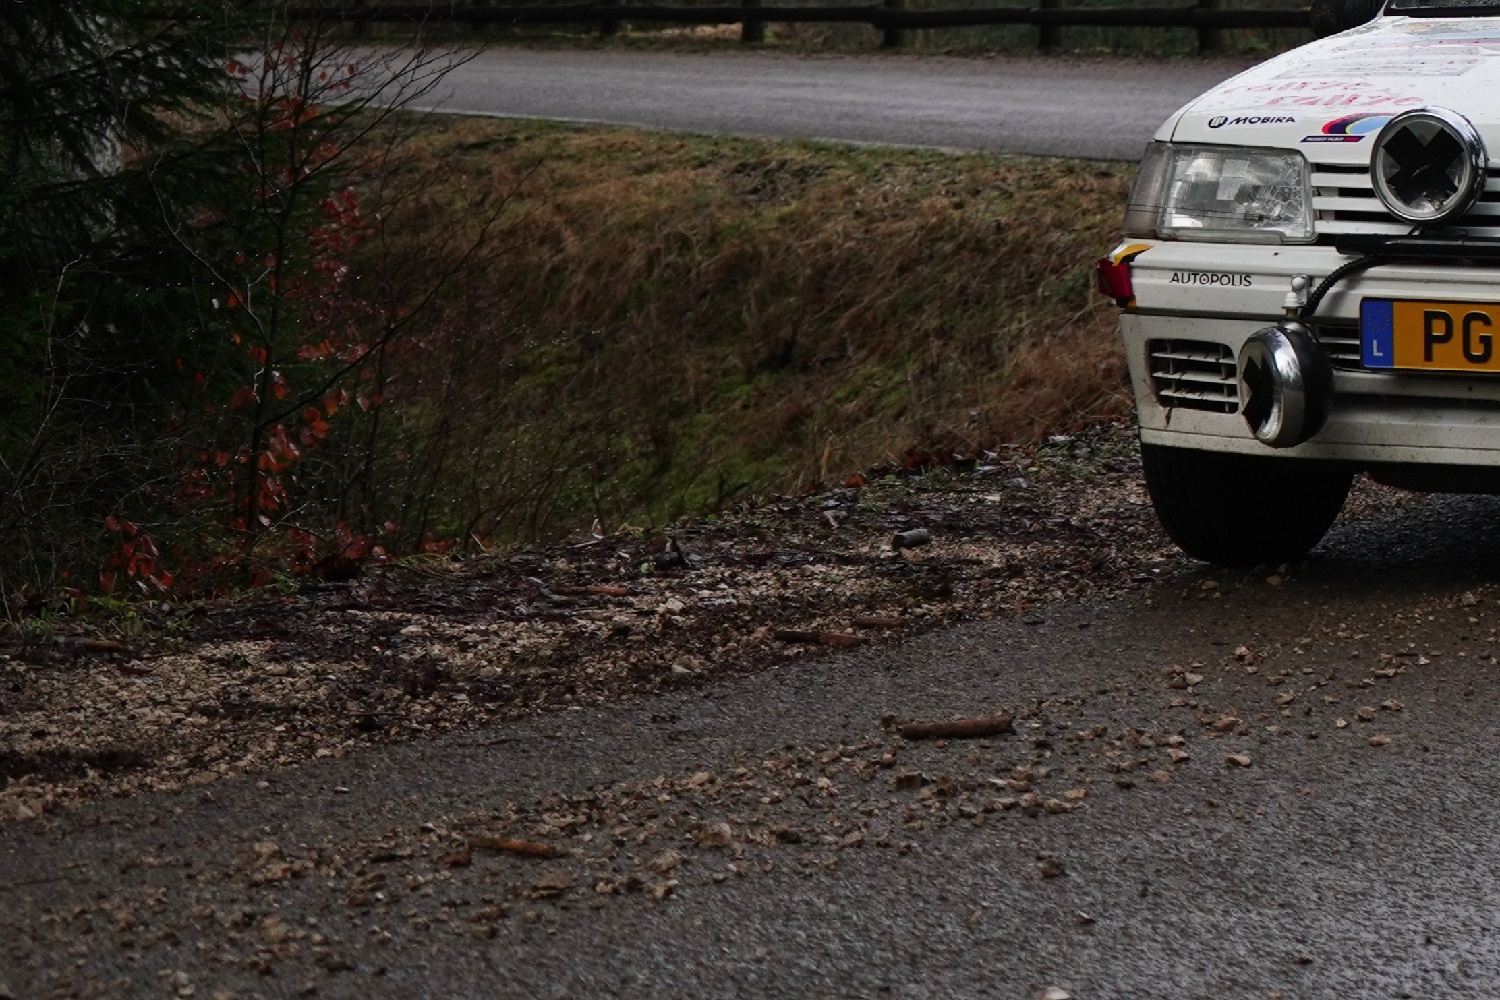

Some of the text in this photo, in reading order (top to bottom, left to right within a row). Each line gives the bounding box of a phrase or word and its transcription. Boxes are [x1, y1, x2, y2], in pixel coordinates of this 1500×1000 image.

[1267, 95, 1424, 106] rallye
[1228, 116, 1296, 126] MOBIRA
[1169, 272, 1252, 286] AUTOPOLIS
[1423, 309, 1493, 363] PG
[1373, 339, 1383, 356] L
